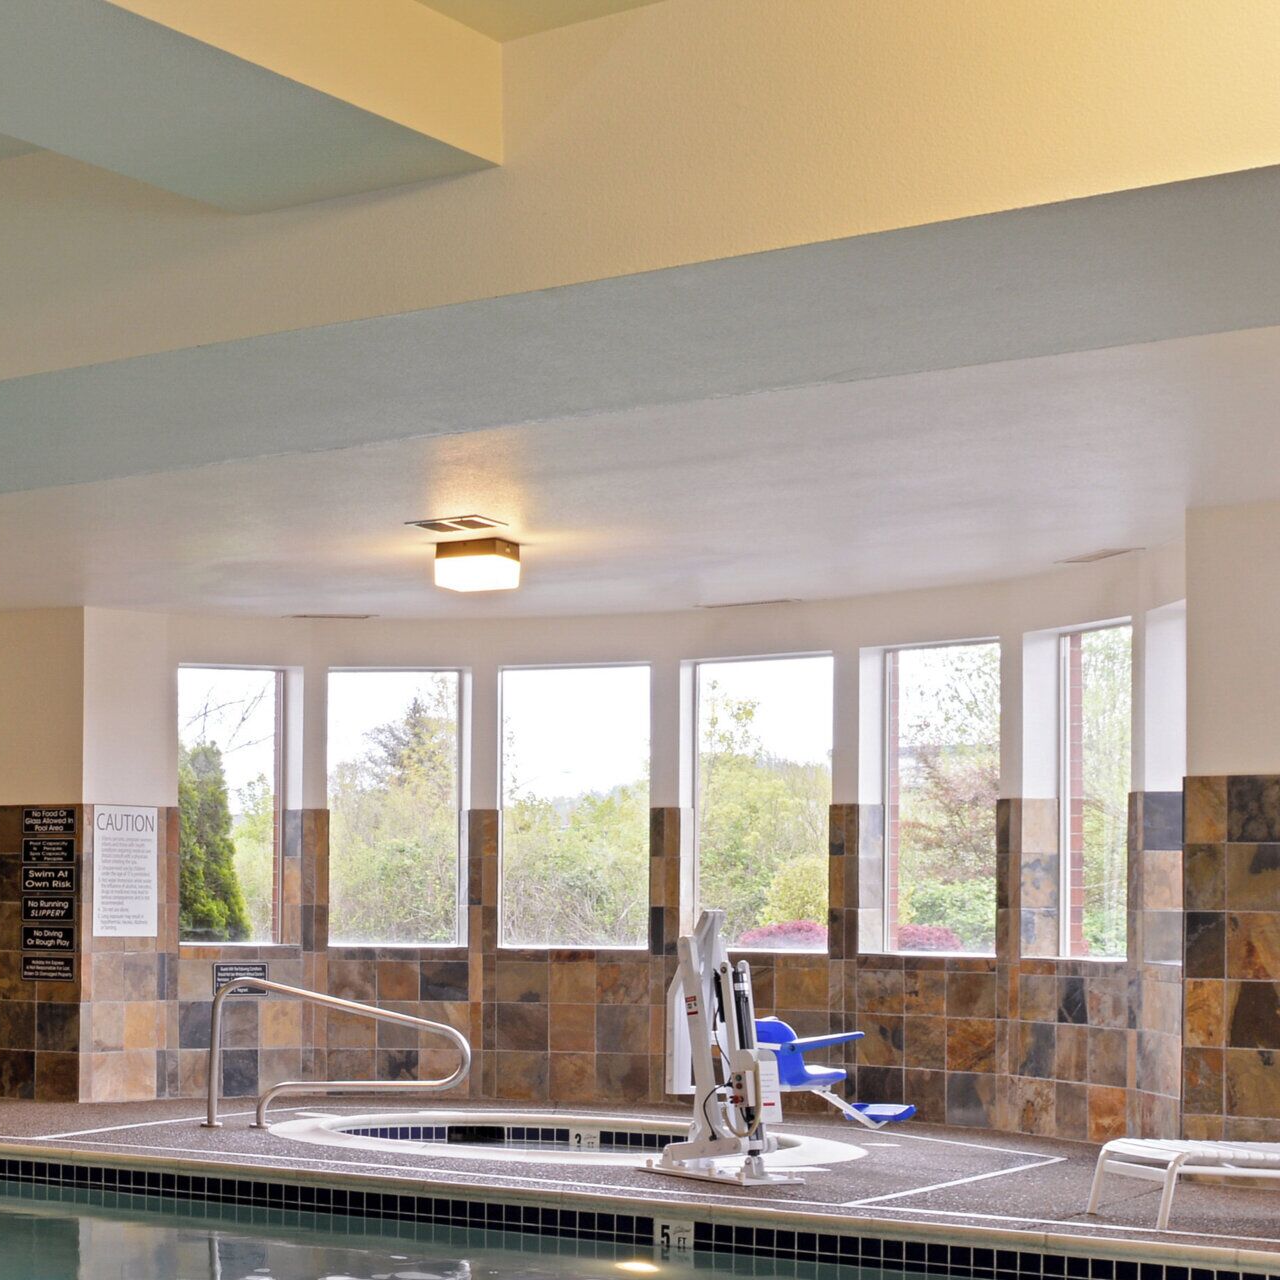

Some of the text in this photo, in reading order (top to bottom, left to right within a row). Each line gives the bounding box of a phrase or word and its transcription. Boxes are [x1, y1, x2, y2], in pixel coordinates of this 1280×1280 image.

[96, 812, 155, 832] CAUTION
[28, 869, 69, 878] Swim At
[25, 879, 71, 888] Own Risk
[27, 900, 69, 909] No Running
[30, 909, 66, 917] SLIPPERY
[43, 930, 64, 938] Diving
[26, 938, 70, 947] Or Rough Play
[660, 1224, 671, 1248] 5
[677, 1236, 687, 1246] FT
